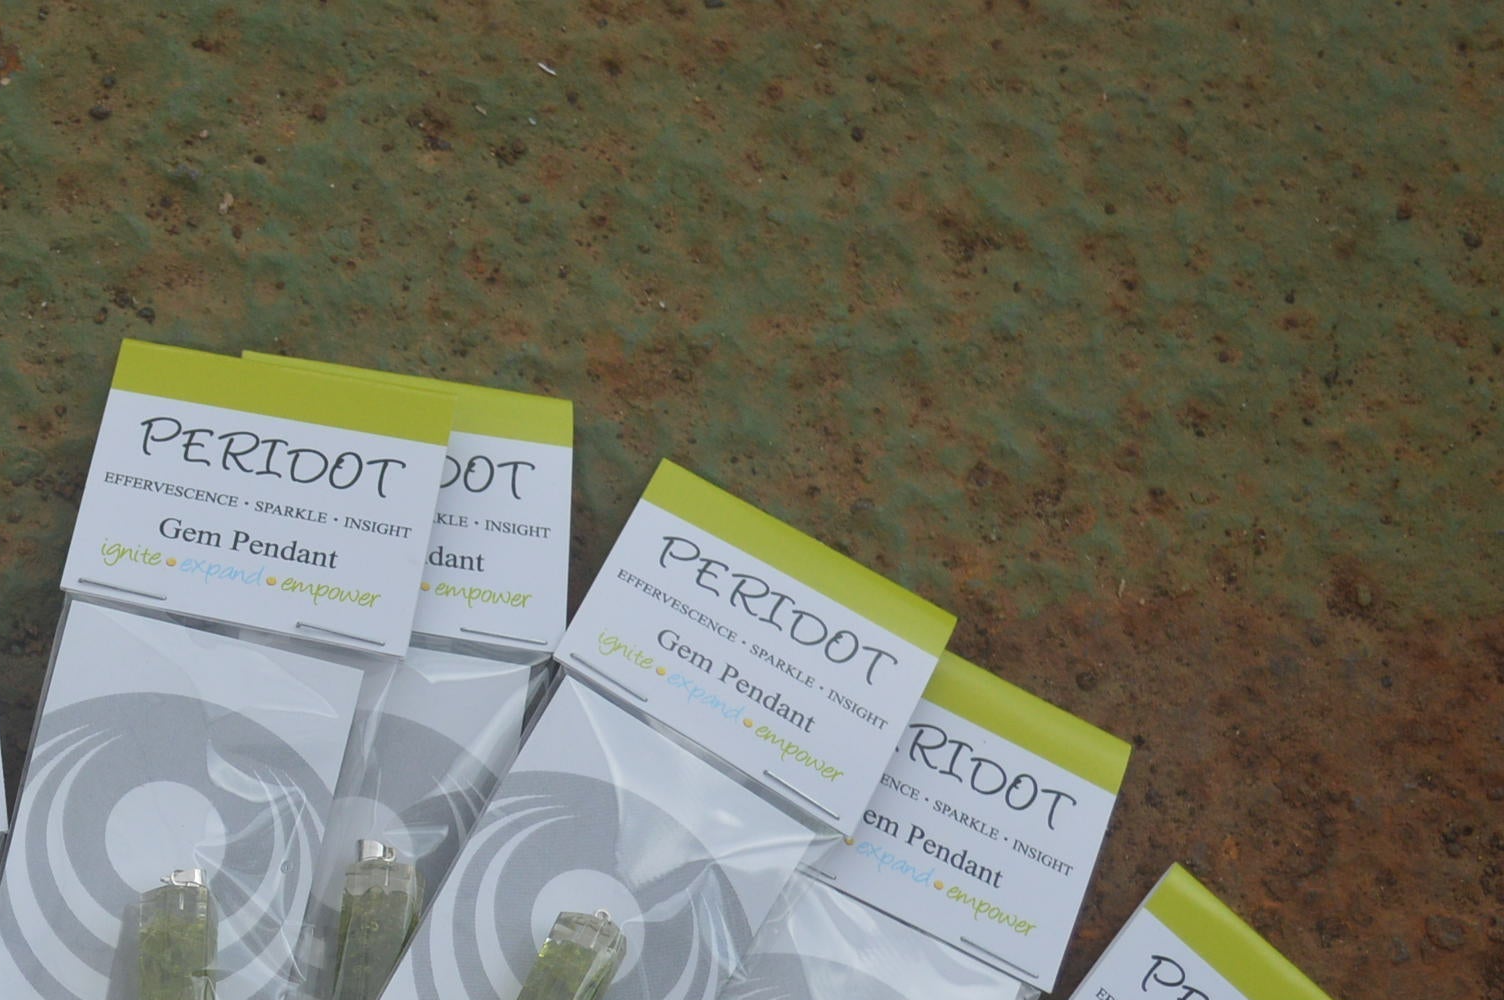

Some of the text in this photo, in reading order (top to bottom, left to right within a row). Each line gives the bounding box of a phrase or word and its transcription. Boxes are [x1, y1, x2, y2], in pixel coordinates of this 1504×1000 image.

[140, 416, 406, 498] PERIDOT
[104, 471, 239, 508] EFFERVESCENCE
[254, 500, 327, 525] SPARKLE
[343, 516, 412, 540] INSIGHT
[158, 517, 339, 571] Gem Pendant
[485, 519, 551, 538] INSIGHT
[99, 537, 381, 609] ignite expand empower
[428, 546, 485, 572] dant
[434, 582, 532, 608] empower
[617, 569, 889, 731] EFFERVESCENCE SPARKLE INSIGHT
[658, 535, 898, 686] PERIDOT
[598, 627, 844, 782] ignite expand empower
[657, 628, 816, 734] Gem Pendant
[896, 723, 1077, 830] RIDOT
[862, 807, 1003, 889] em Pendant
[933, 799, 1074, 877] SPARKLE INSIGHT
[856, 839, 1037, 936] expand empower
